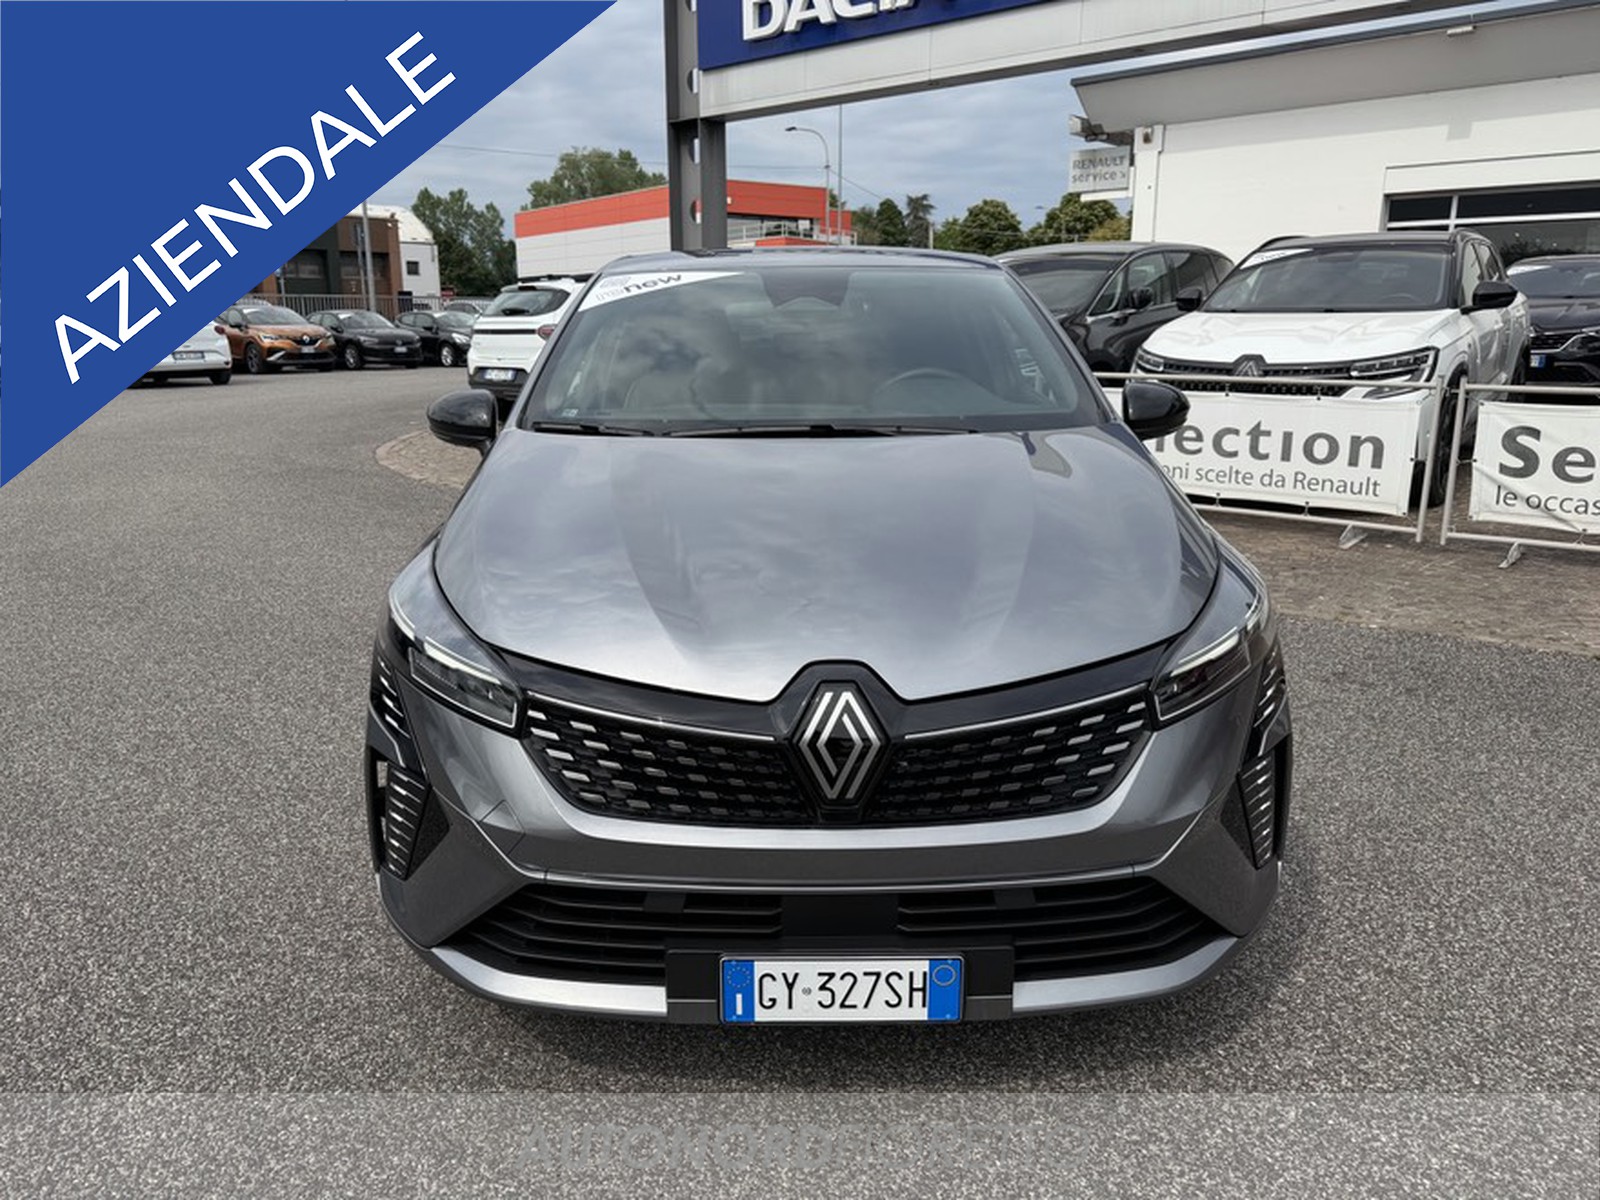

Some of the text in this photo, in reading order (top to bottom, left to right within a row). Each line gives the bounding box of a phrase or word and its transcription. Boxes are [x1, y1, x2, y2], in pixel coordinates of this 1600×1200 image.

[1072, 156, 1126, 170] RENAULT
[1071, 171, 1117, 184] service
[1195, 465, 1254, 486] scelte
[1259, 468, 1286, 489] da
[1293, 470, 1381, 498] Renault
[1496, 484, 1518, 507] le
[758, 972, 799, 1010] GY
[817, 971, 928, 1009] 327SH
